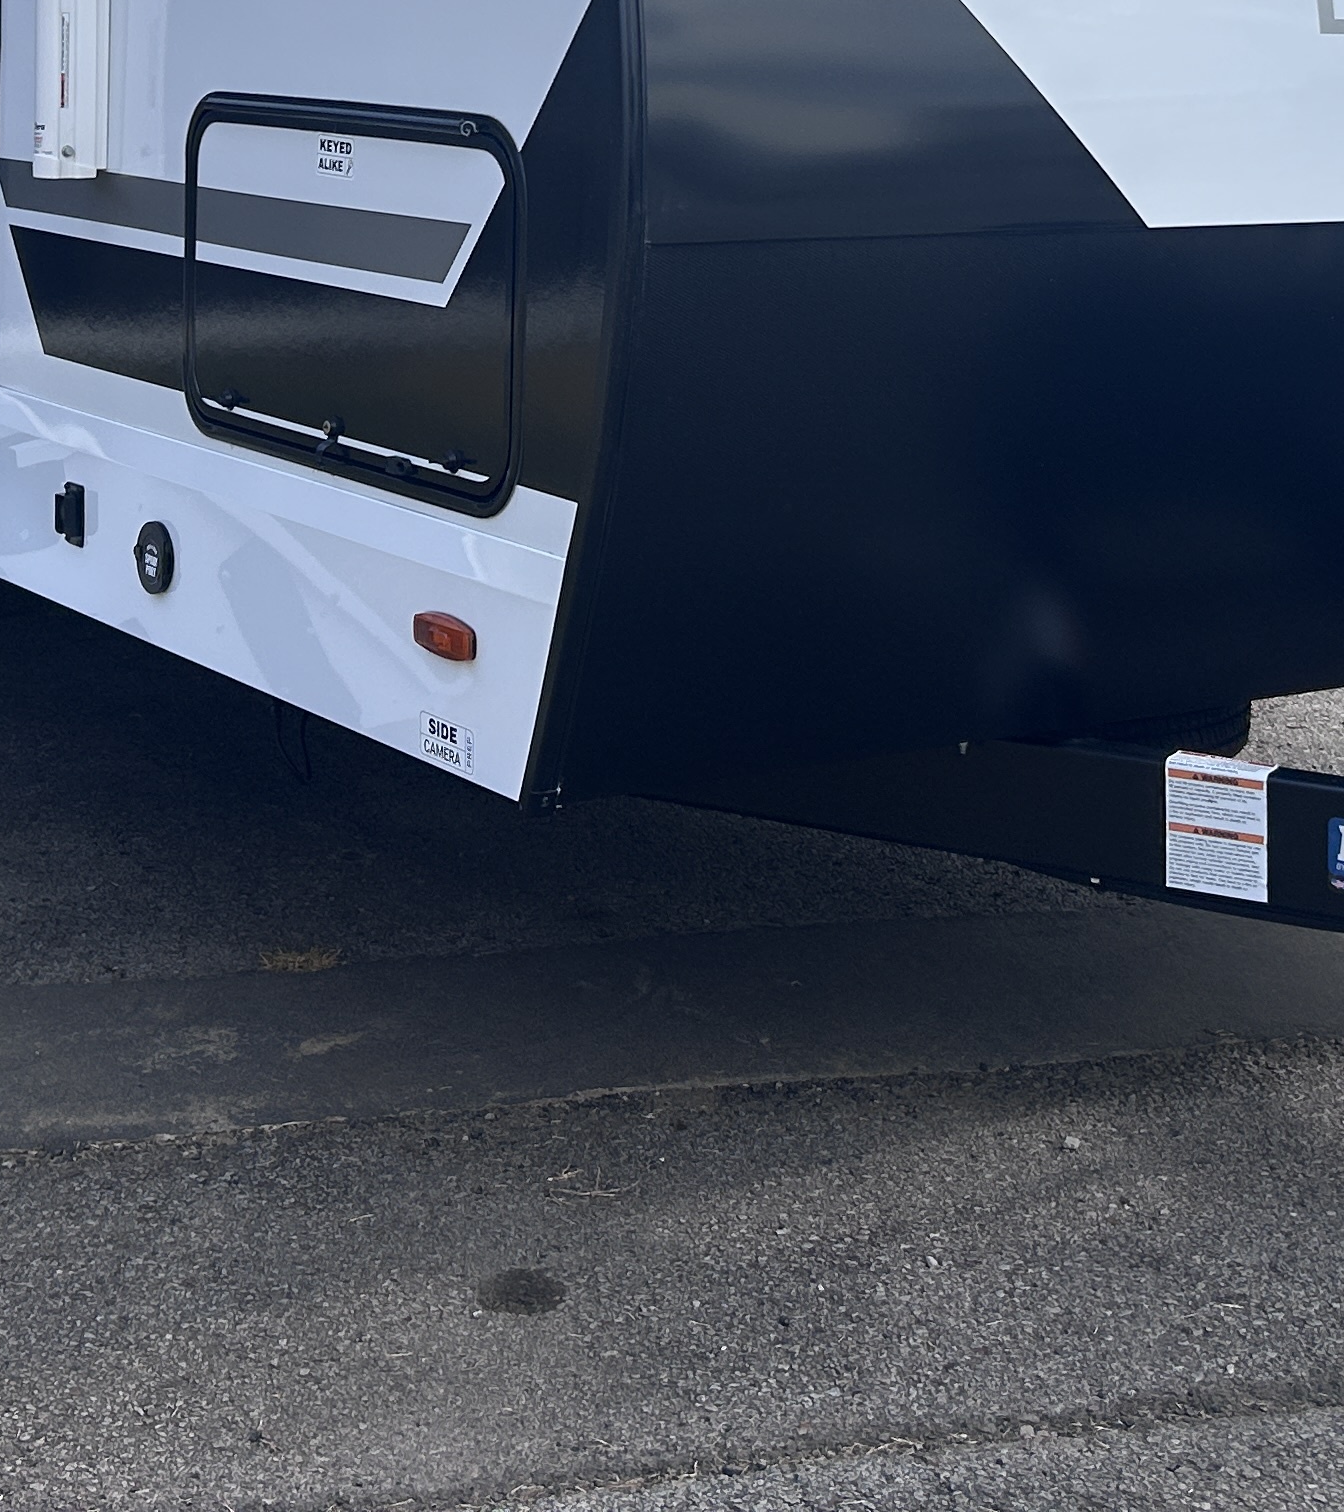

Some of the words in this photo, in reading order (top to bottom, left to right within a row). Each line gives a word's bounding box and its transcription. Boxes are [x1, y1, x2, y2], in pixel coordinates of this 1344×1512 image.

[320, 138, 352, 155] KEYED
[318, 157, 343, 172] ALIKE
[428, 718, 458, 745] SIDE
[423, 738, 461, 767] CAMERA
